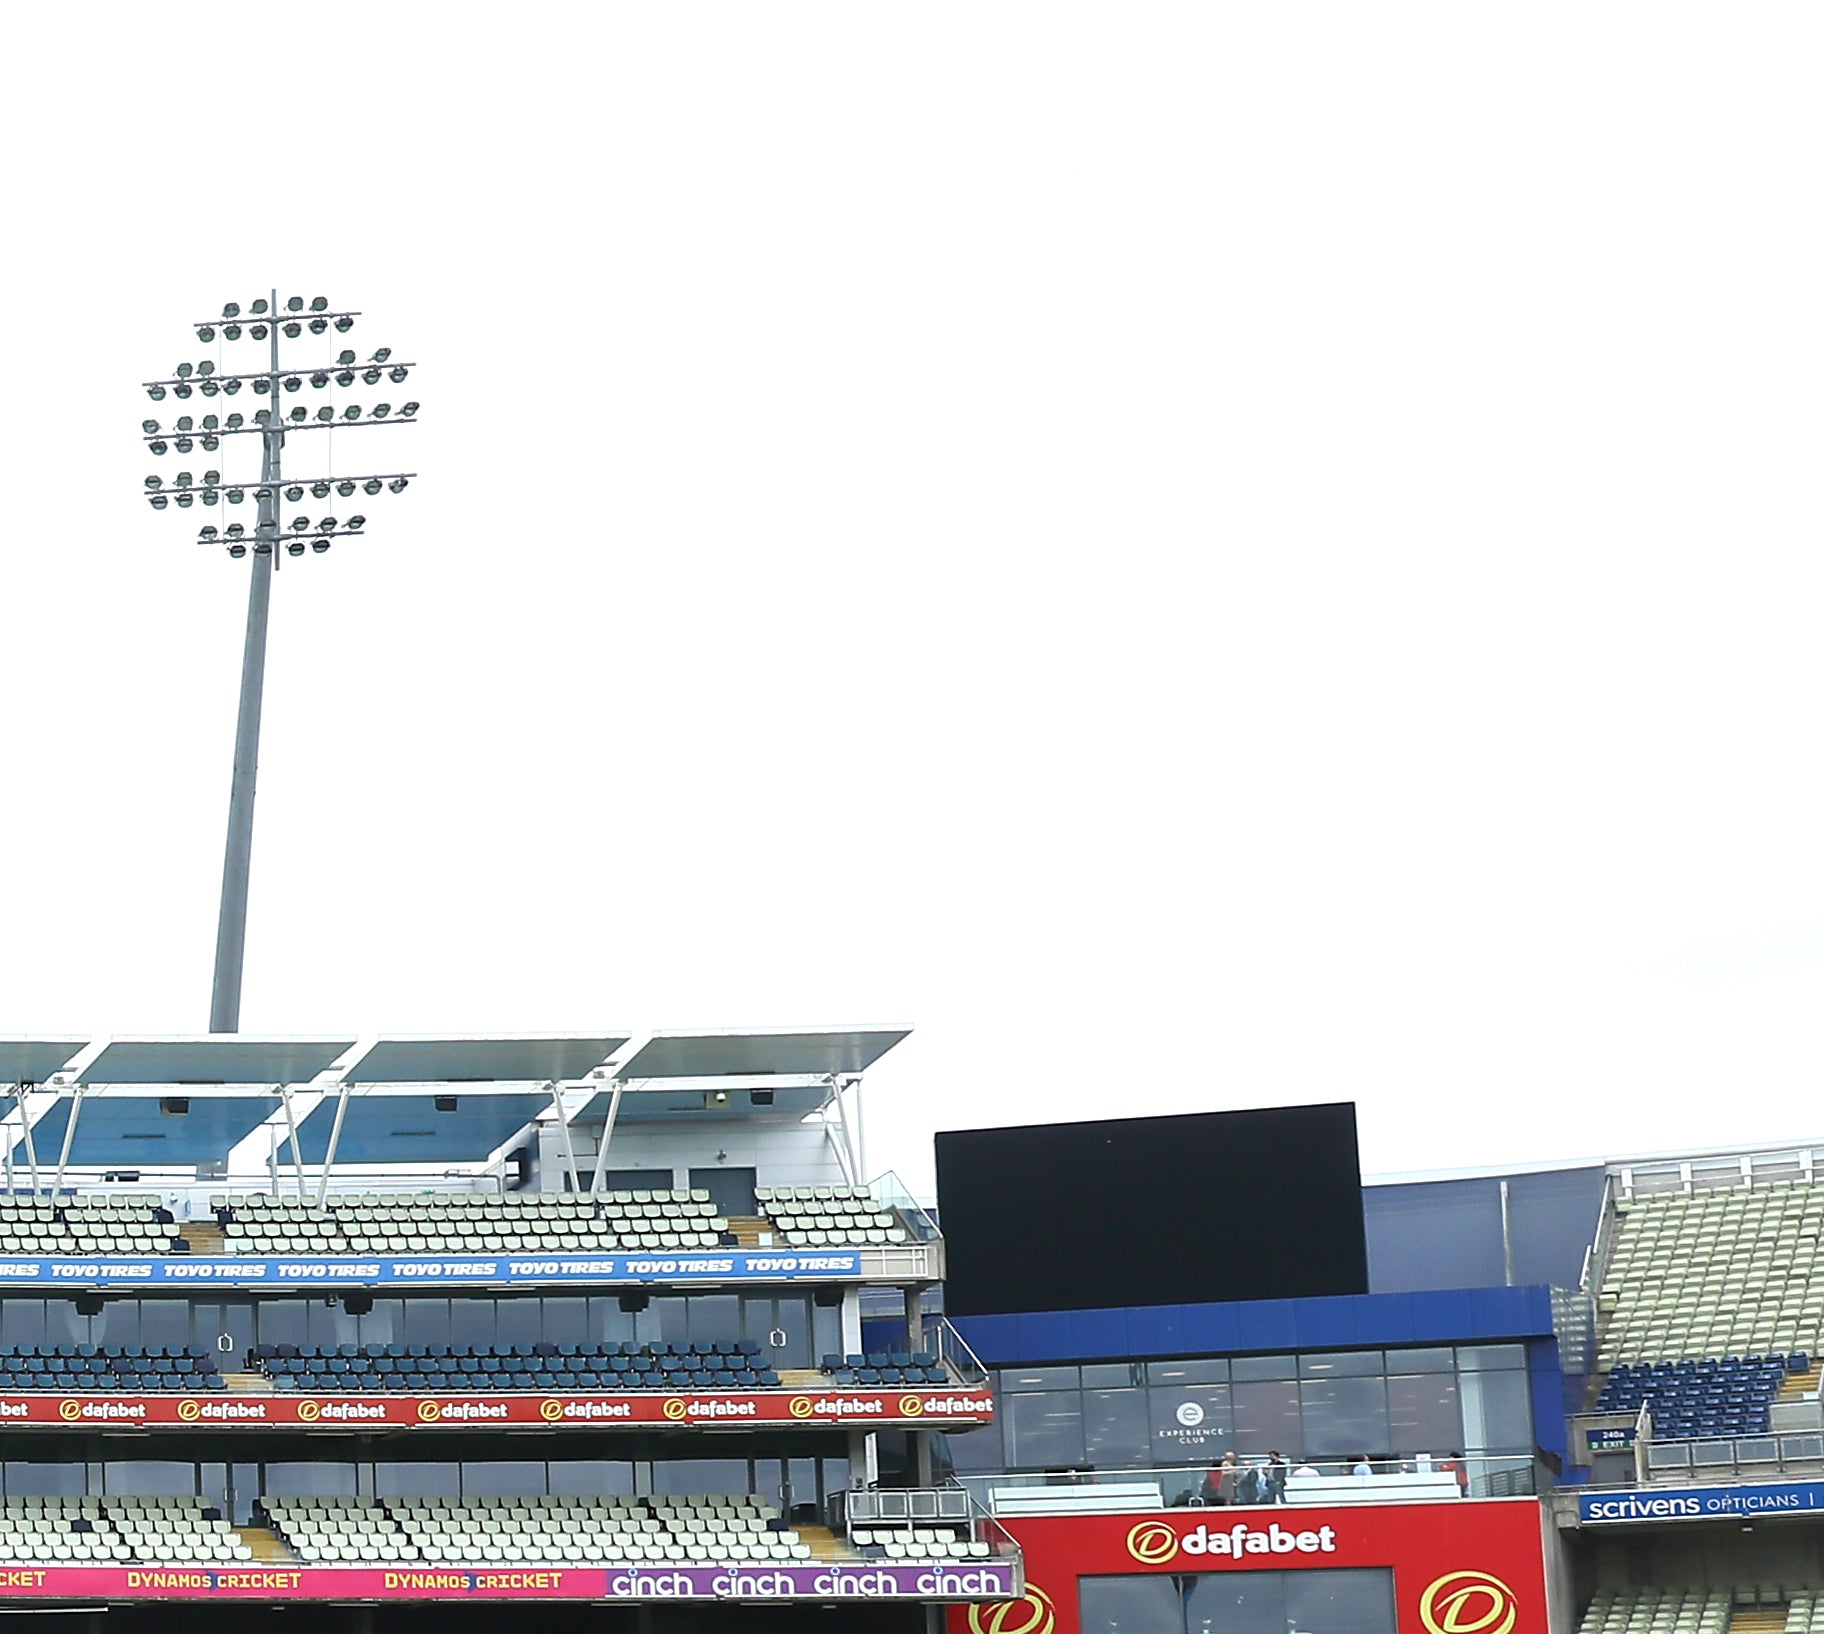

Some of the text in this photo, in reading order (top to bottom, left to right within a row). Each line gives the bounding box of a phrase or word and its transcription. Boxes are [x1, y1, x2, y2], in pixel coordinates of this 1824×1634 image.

[164, 1265, 266, 1276] TOYO TIRES
[278, 1265, 380, 1276] TOYO TIRES
[510, 1262, 614, 1274] TOYO TIRES
[626, 1260, 733, 1273] TOYO TIRES
[746, 1257, 854, 1270] TOYO TIRES
[82, 1402, 145, 1419] dafabet
[201, 1403, 265, 1419] dafabet
[441, 1403, 507, 1420] dafabet
[564, 1402, 630, 1418] dafabet
[688, 1401, 755, 1417] dafabet
[814, 1399, 882, 1415] dafabet
[924, 1397, 992, 1414] dafabet
[1159, 1428, 1224, 1437] EXPERIENCE
[1179, 1436, 1205, 1445] CLUB
[1603, 1440, 1628, 1449] EXIT
[1590, 1494, 1799, 1518] scrivens OPTICIANS
[1182, 1524, 1335, 1559] dafabet
[128, 1572, 301, 1588] DYNAMOS CRICKET
[385, 1573, 562, 1588] DYNAMOS CRICKET
[613, 1568, 693, 1597] cinch
[712, 1568, 795, 1596] cinch
[813, 1567, 898, 1595] cinch
[916, 1566, 1000, 1594] cinch
